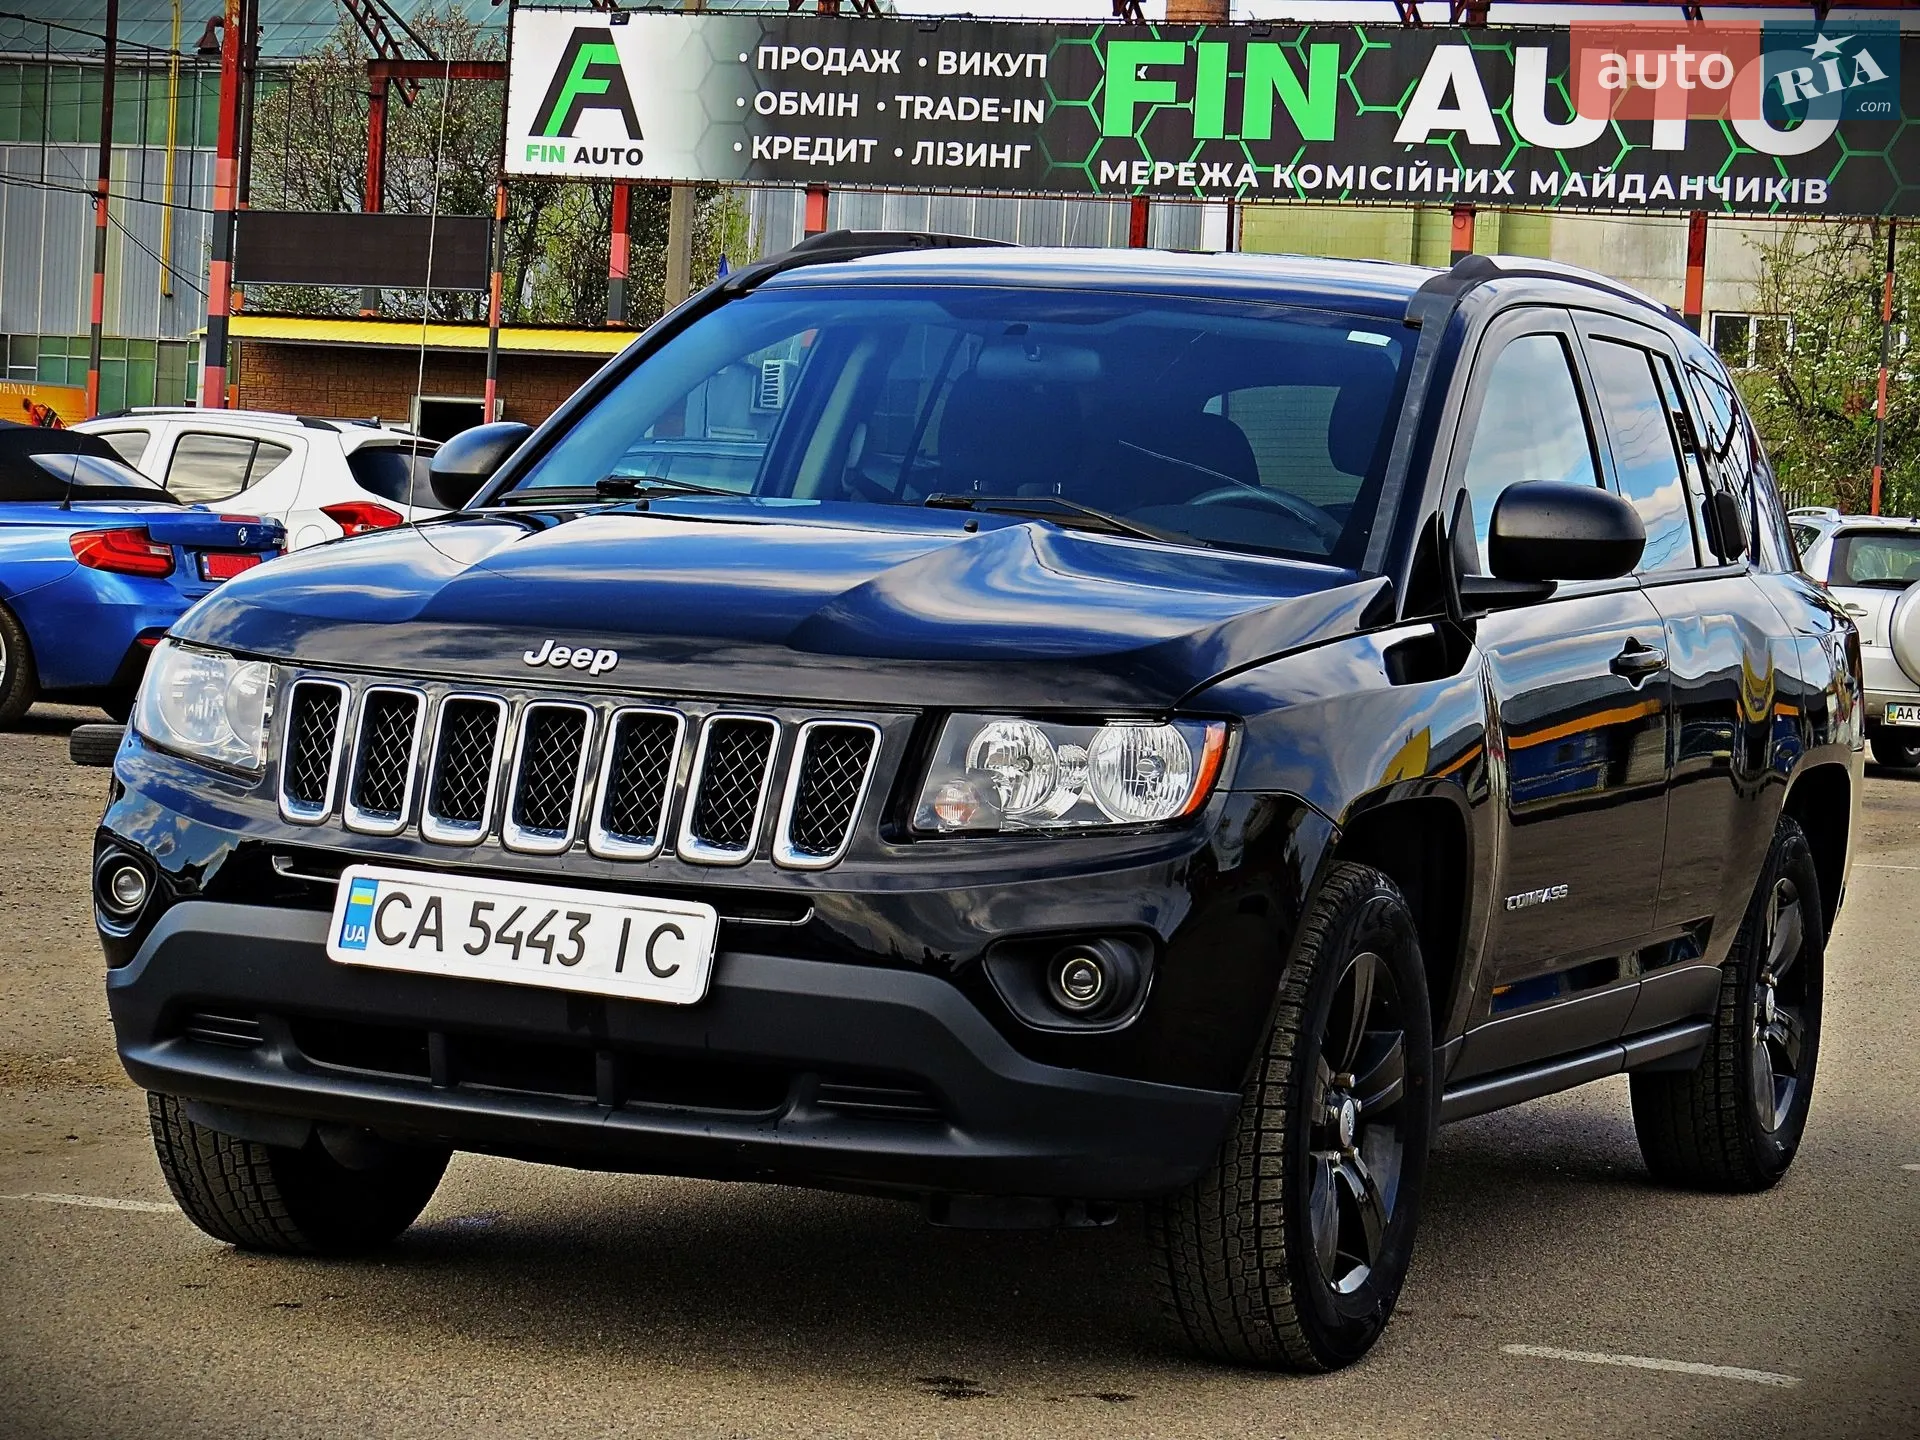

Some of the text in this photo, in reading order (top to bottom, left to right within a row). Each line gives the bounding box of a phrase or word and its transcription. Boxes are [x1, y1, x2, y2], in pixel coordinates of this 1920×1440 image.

[757, 46, 1047, 78] ПРОДАЖ ВИКУП
[754, 90, 1045, 124] ОБМІН TRADE-IN
[1103, 40, 1844, 156] FIN AUTO
[525, 144, 644, 166] FIN AUTO
[751, 135, 1031, 169] КРЕДИТ ЛІЗИНГ
[1100, 160, 1831, 204] МЕРЕЖА КОМІСІЙНИХ МАЙДАНЧИКІВ
[523, 639, 619, 676] Jeep
[1896, 706, 1914, 720] AA
[344, 924, 366, 943] UA
[374, 891, 685, 979] CA 5443 IC
